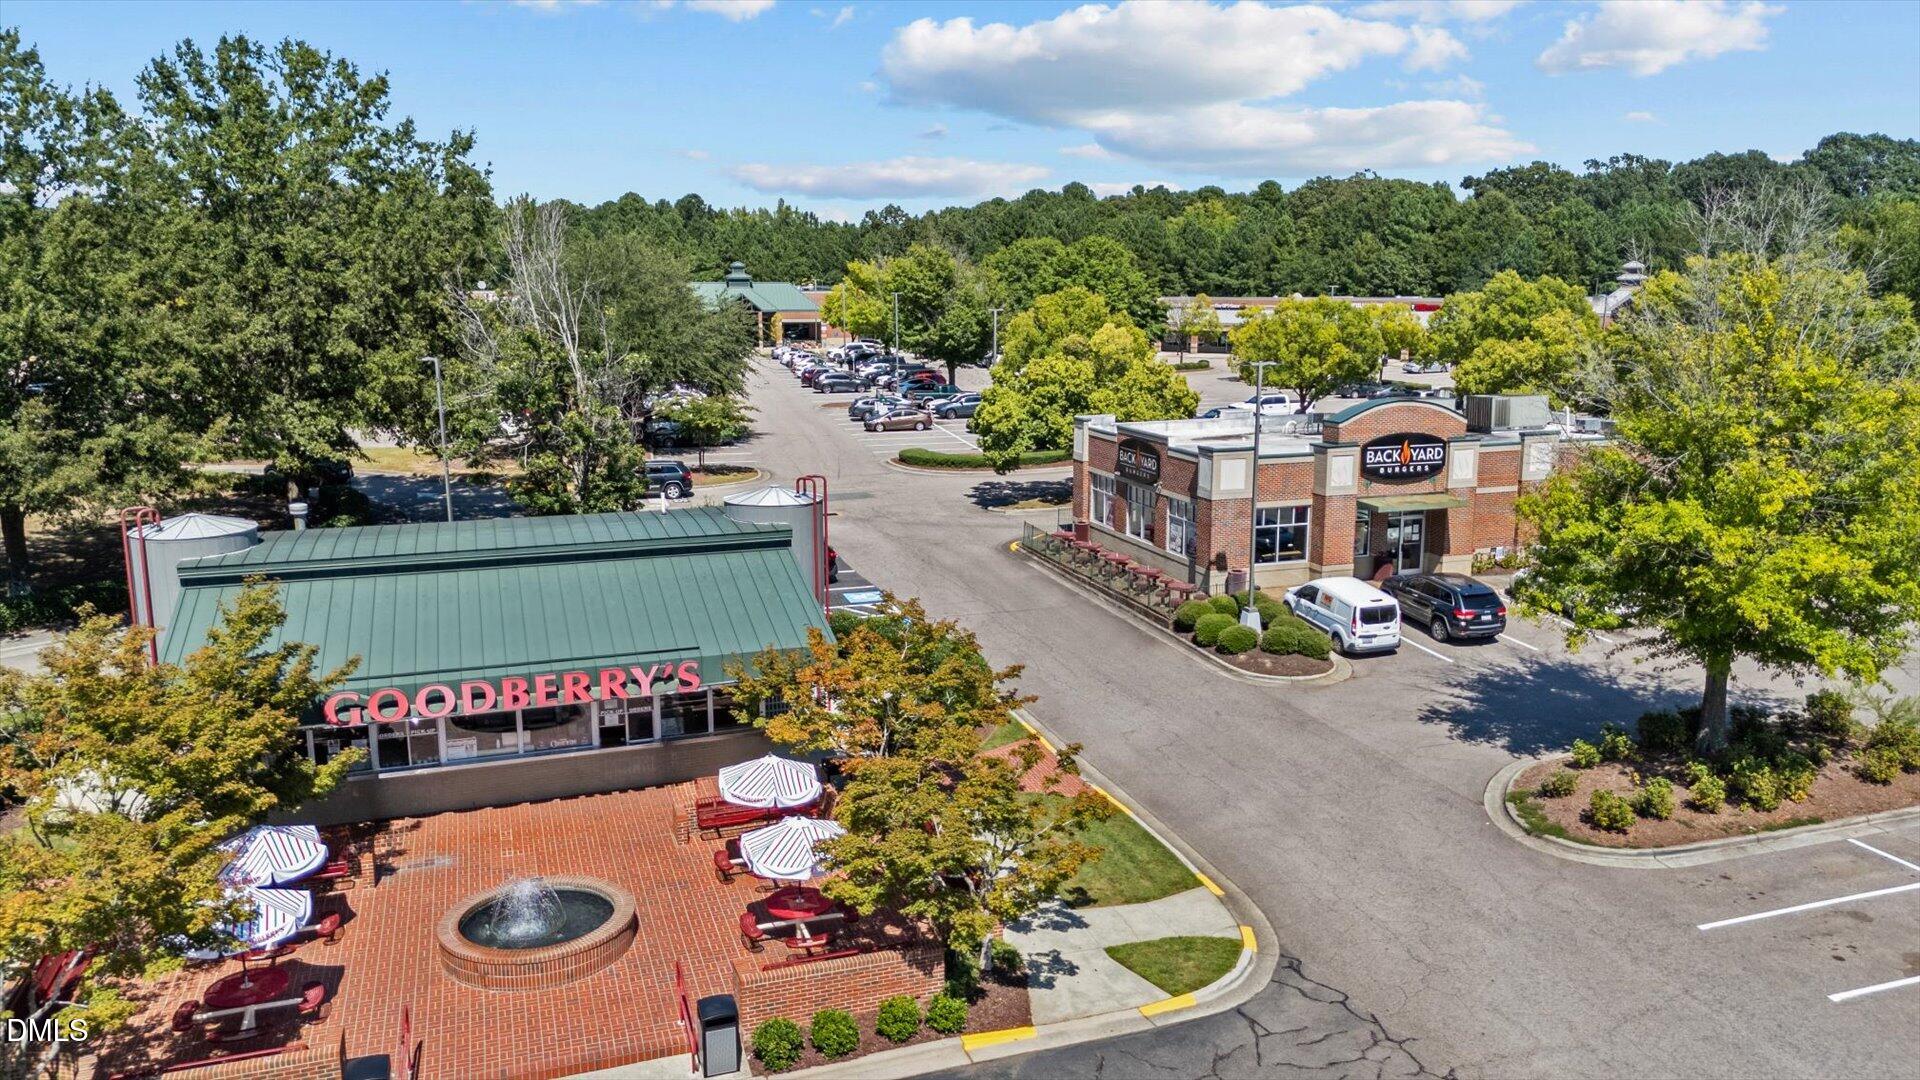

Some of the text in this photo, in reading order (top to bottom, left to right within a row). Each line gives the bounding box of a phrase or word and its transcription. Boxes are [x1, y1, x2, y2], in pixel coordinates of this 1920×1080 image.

[1119, 450, 1157, 470] BACK YARD
[1366, 447, 1443, 463] BACK YARD
[1379, 465, 1429, 474] BURGERS
[323, 660, 701, 727] GOODBERRY'S
